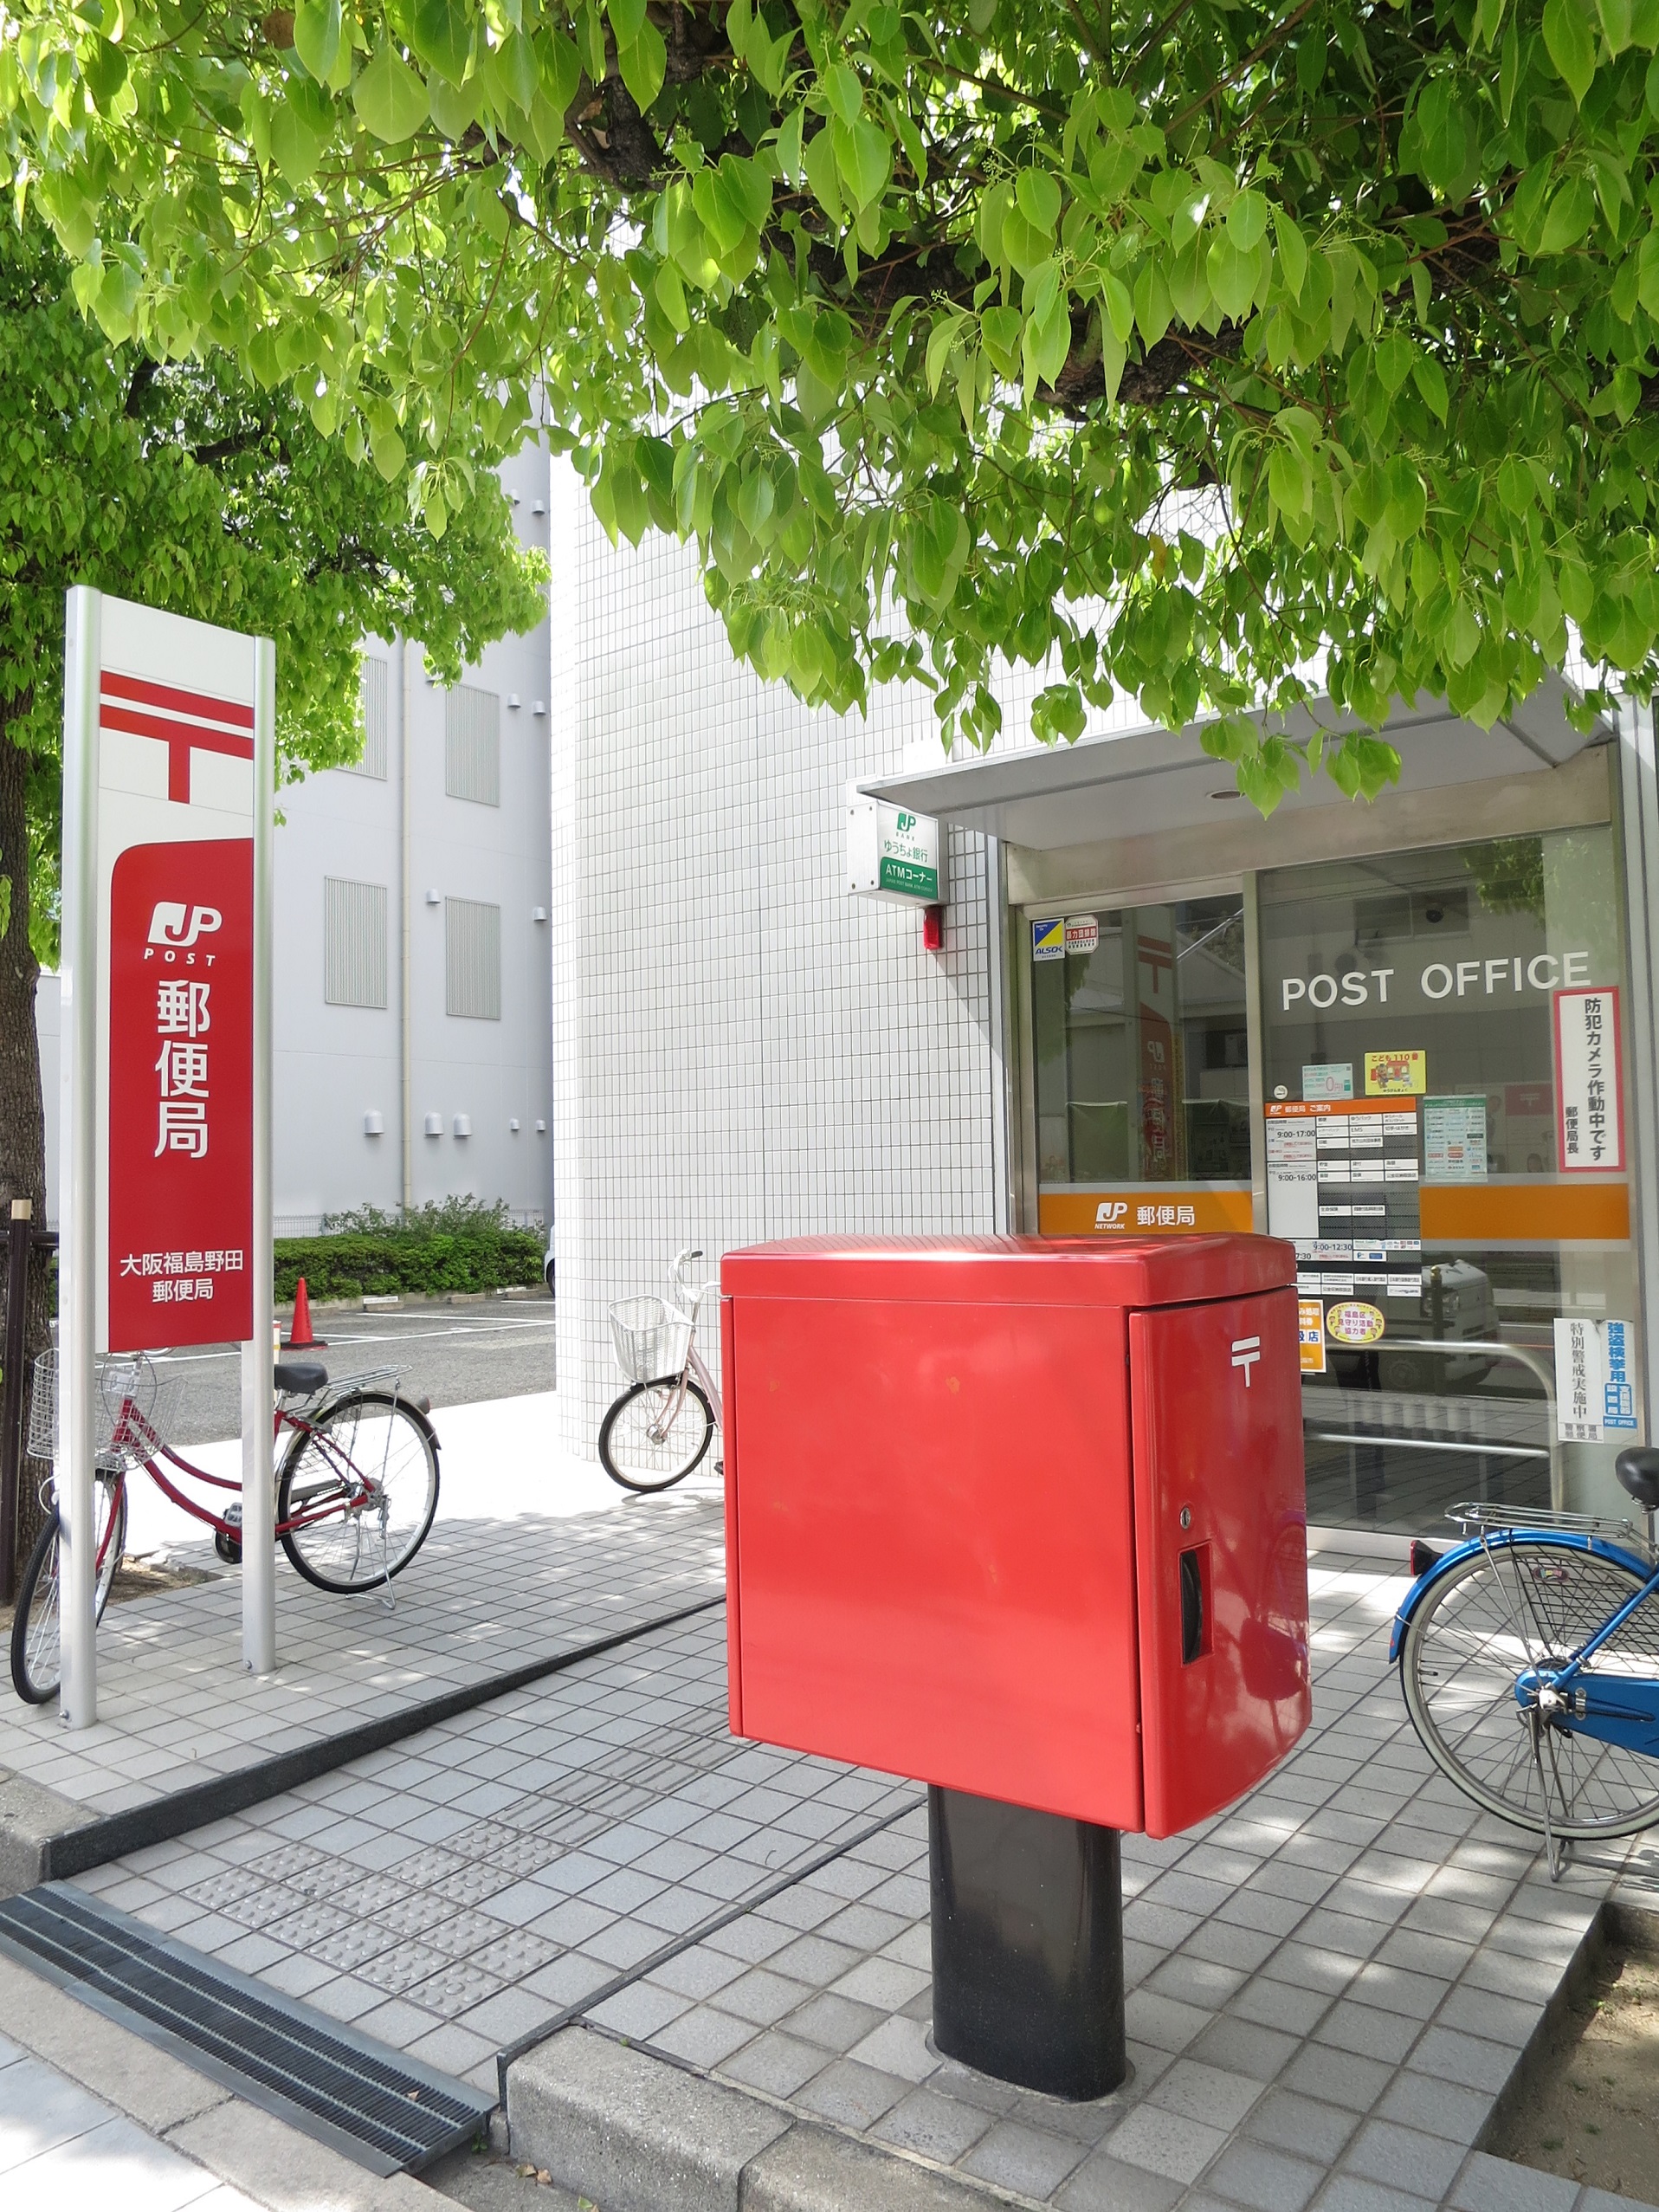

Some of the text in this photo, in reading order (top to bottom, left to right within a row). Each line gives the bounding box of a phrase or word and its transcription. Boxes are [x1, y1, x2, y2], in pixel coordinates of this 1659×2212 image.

[897, 812, 916, 831] JP
[884, 839, 928, 863] ゆうちょ銀行
[885, 863, 933, 883] ATMコーナー
[147, 902, 223, 947] JP
[144, 948, 216, 967] POST
[1036, 946, 1063, 954] ALSOK
[1281, 951, 1591, 1011] POST OFFICE
[154, 979, 211, 1159] 郵便局
[1585, 998, 1606, 1161] 防犯カメラ作動中です
[1277, 1129, 1316, 1139] 9:00-17:00
[1565, 1106, 1579, 1154] 郵便局長
[1095, 1202, 1127, 1222] JP
[1137, 1206, 1196, 1226] 郵便局
[1313, 1242, 1352, 1251] 9:00-12:30
[119, 1249, 244, 1277] 大阪福島野田
[152, 1277, 214, 1303] 郵便局
[1338, 1318, 1373, 1328] 見守り活動
[1570, 1322, 1587, 1419] 特別警戒実施中
